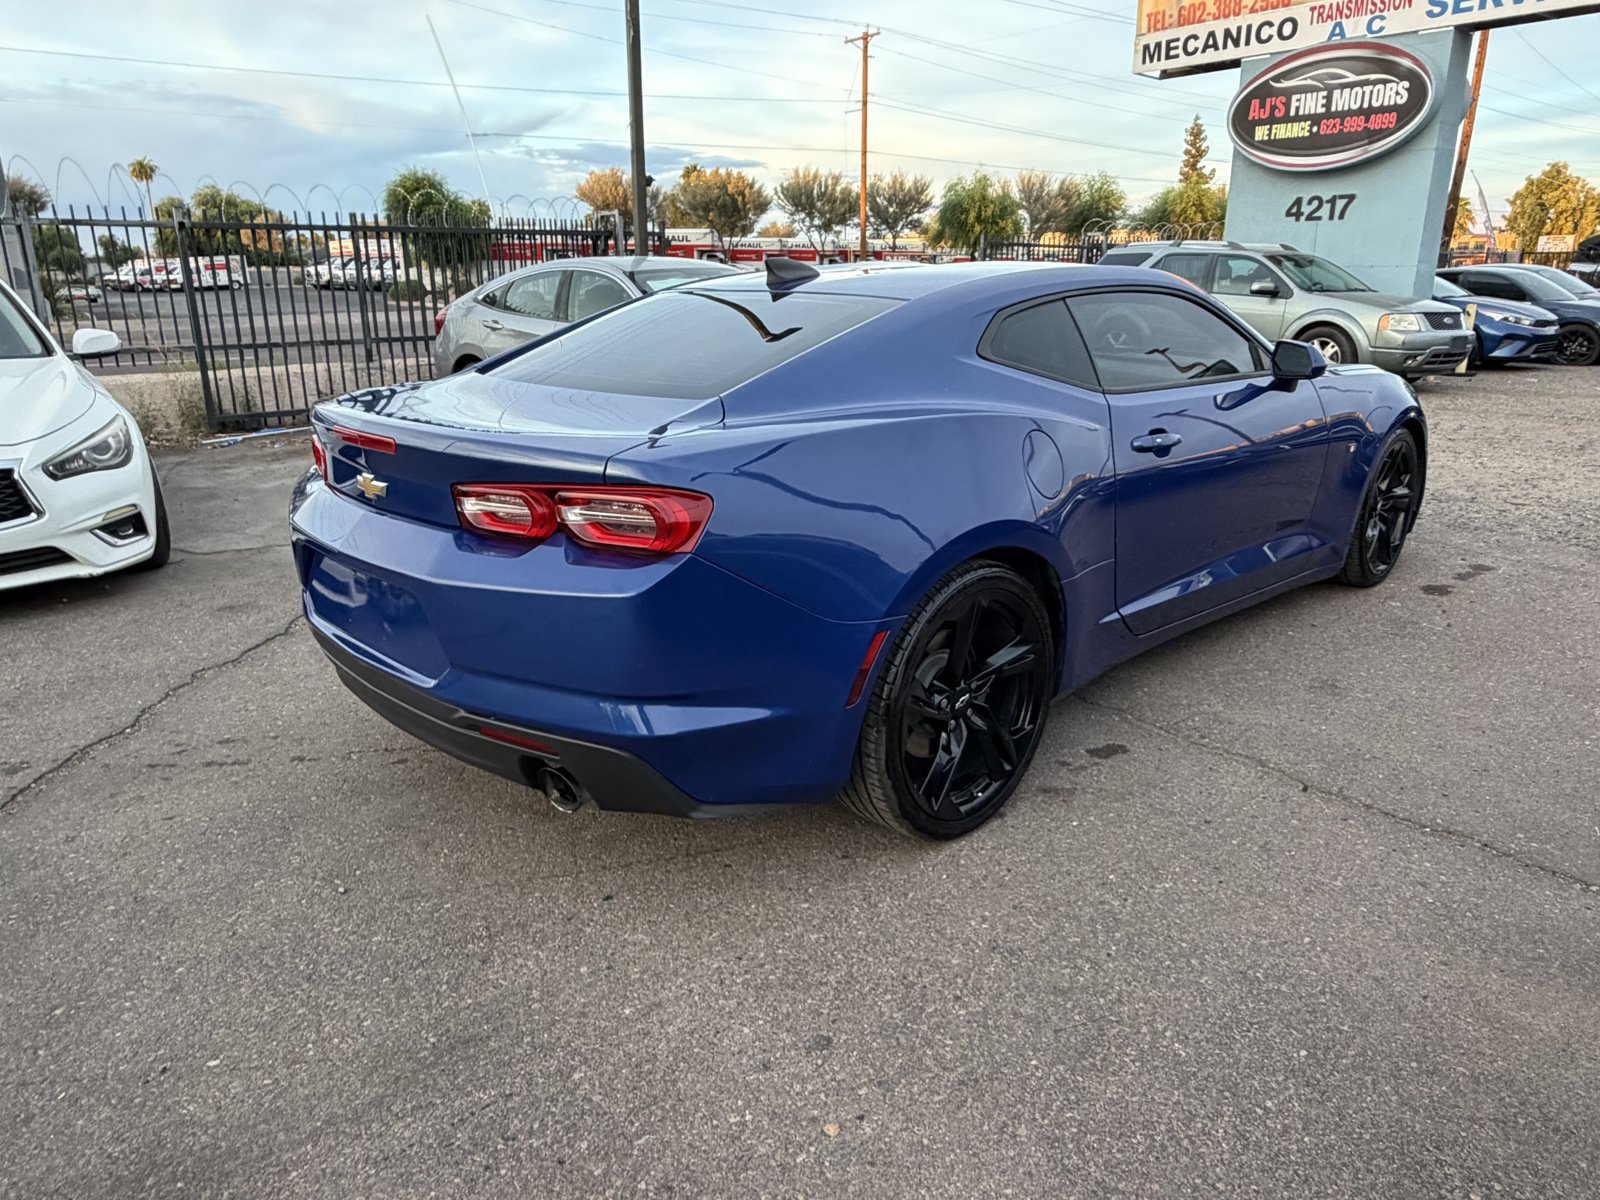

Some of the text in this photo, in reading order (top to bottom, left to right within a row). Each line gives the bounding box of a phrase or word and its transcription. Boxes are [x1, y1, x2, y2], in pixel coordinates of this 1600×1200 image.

[1146, 9, 1173, 33] TEL:
[1327, 14, 1387, 41] A C
[1142, 16, 1299, 65] MECANICO
[1248, 80, 1410, 121] AJ'S FINE MOTORS
[1254, 111, 1398, 142] WE FINANCE 623-999-4899
[1285, 193, 1357, 223] 4217
